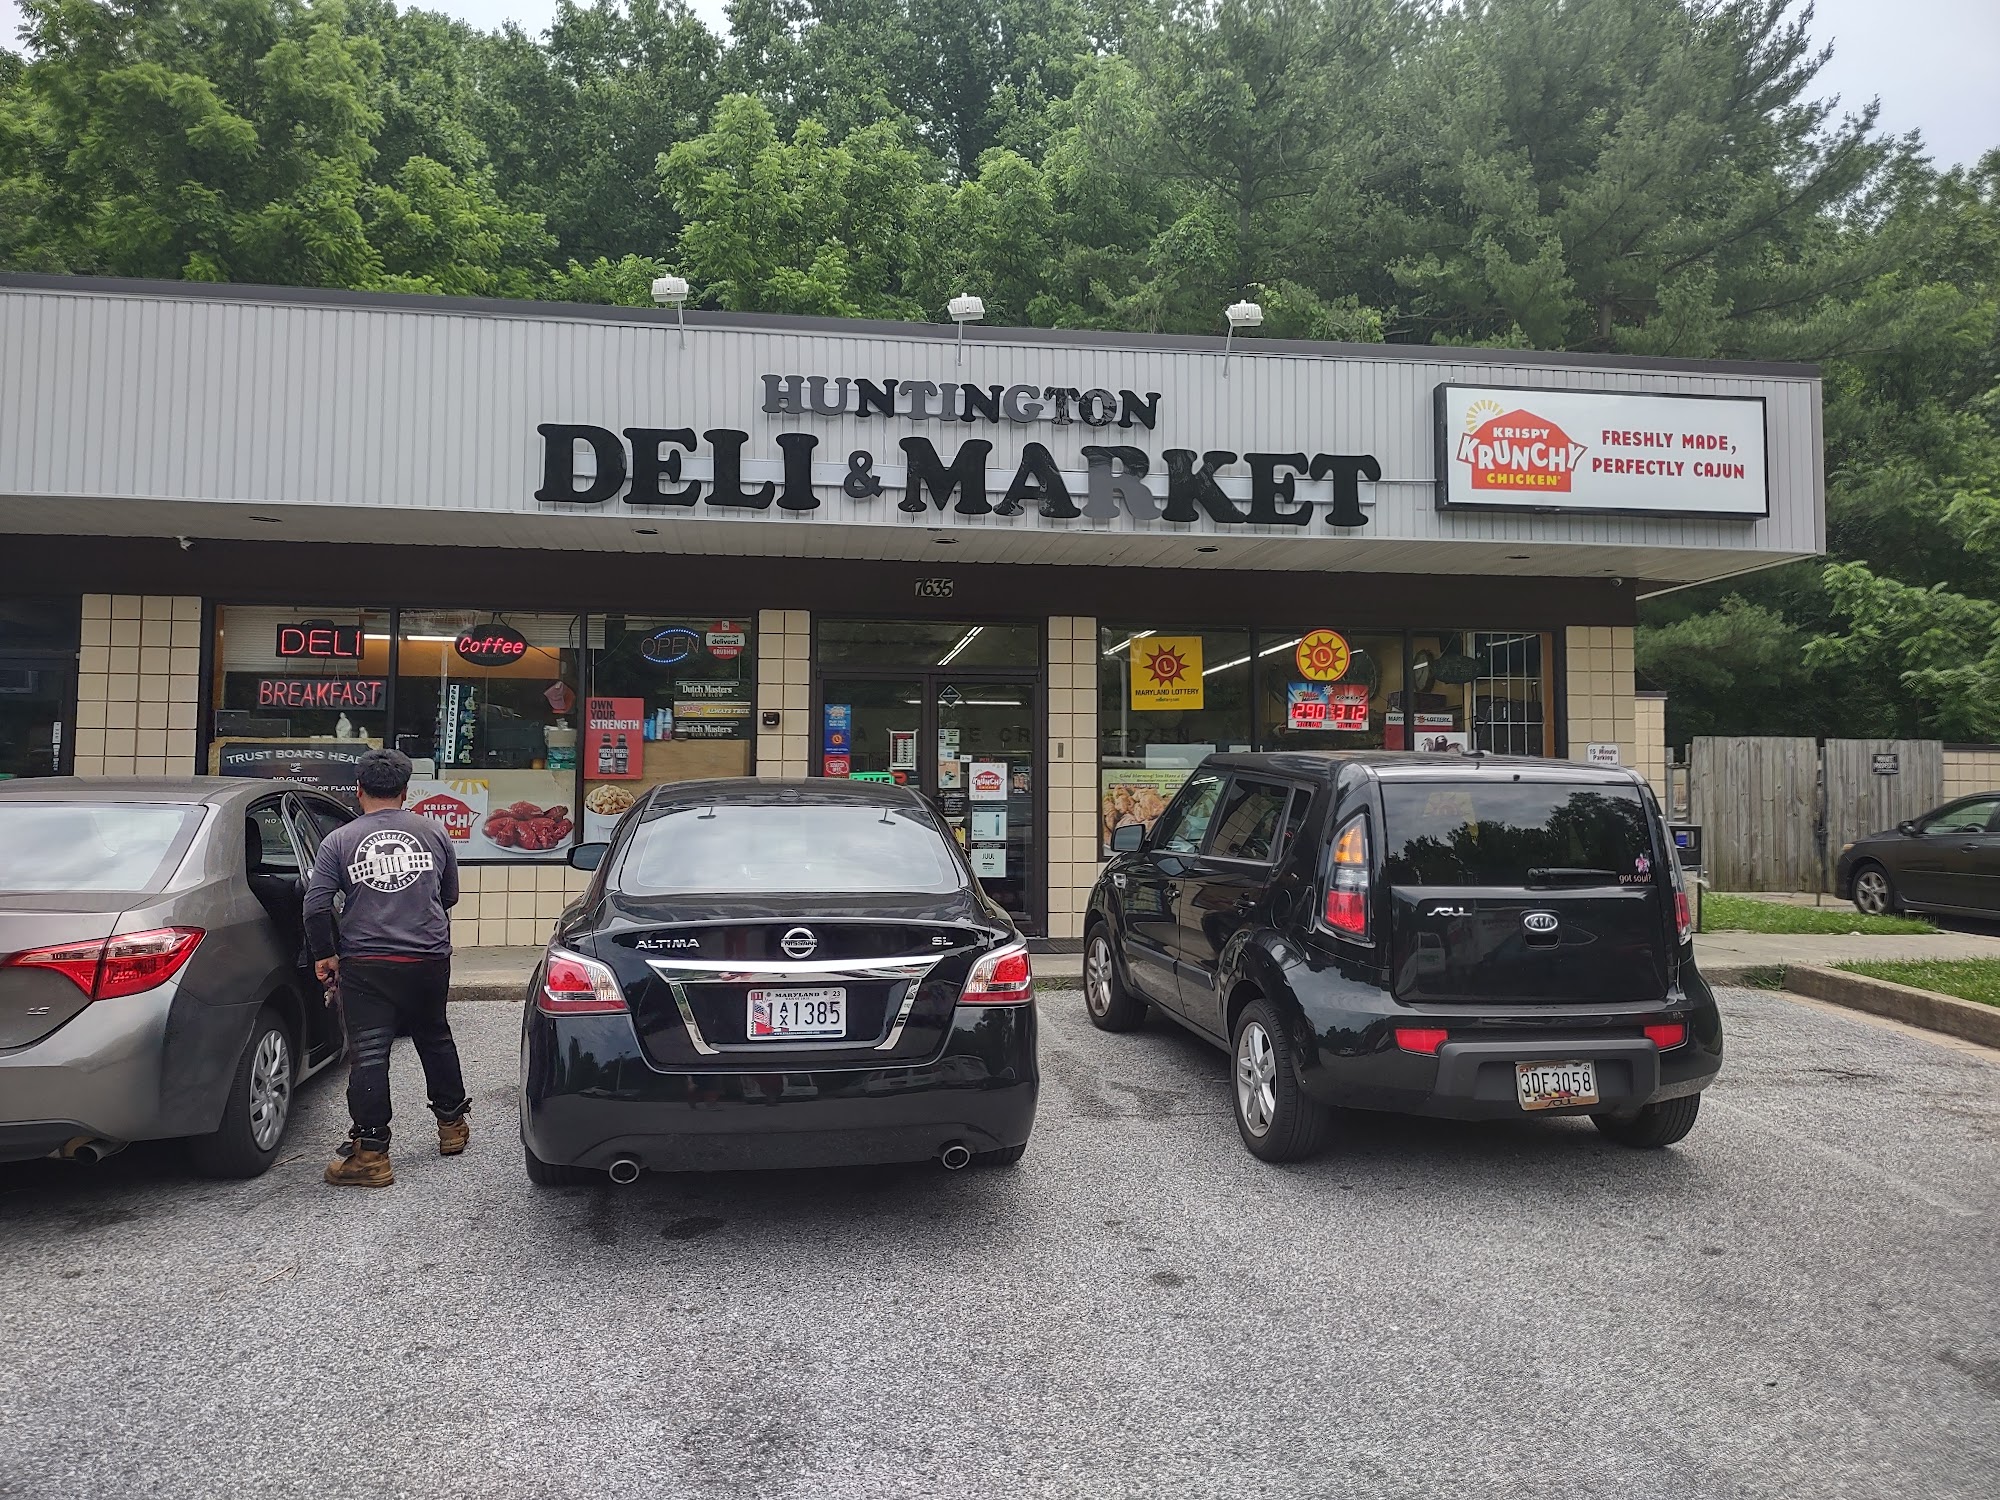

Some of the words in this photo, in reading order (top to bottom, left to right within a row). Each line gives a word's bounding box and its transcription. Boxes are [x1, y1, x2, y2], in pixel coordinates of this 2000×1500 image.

[761, 374, 1161, 430] HUNTINGTON
[1493, 427, 1550, 439] KRISPY
[1602, 430, 1673, 448] FRESHLY
[1682, 433, 1736, 455] MADE,
[1457, 435, 1586, 472] KRUNCHY
[1592, 457, 1685, 476] PERFECTLY
[1693, 461, 1744, 479] CAJUN
[534, 423, 820, 510] DELI
[844, 450, 884, 498] &
[898, 436, 1381, 527] MARKET
[1486, 473, 1558, 486] CHICKEN
[915, 579, 952, 596] 7635
[281, 629, 360, 656] DELI
[459, 636, 524, 654] Coffee
[641, 636, 700, 656] OPEN
[260, 680, 381, 707] BREAKFAST
[682, 685, 703, 694] Dutch
[705, 685, 733, 694] Masters
[591, 701, 613, 709] OWN
[591, 710, 616, 719] YOUR
[590, 720, 640, 730] STRENGTH
[705, 724, 733, 733] Masters
[226, 750, 272, 764] TRUST
[275, 749, 325, 760] BOAR'S
[972, 776, 1004, 786] KRUNCHY
[1619, 874, 1632, 884] got
[1633, 873, 1652, 883] soul?
[1427, 907, 1472, 916] SOUL
[1529, 916, 1552, 928] KIA
[635, 938, 700, 949] ALTIMA
[932, 936, 954, 946] SL
